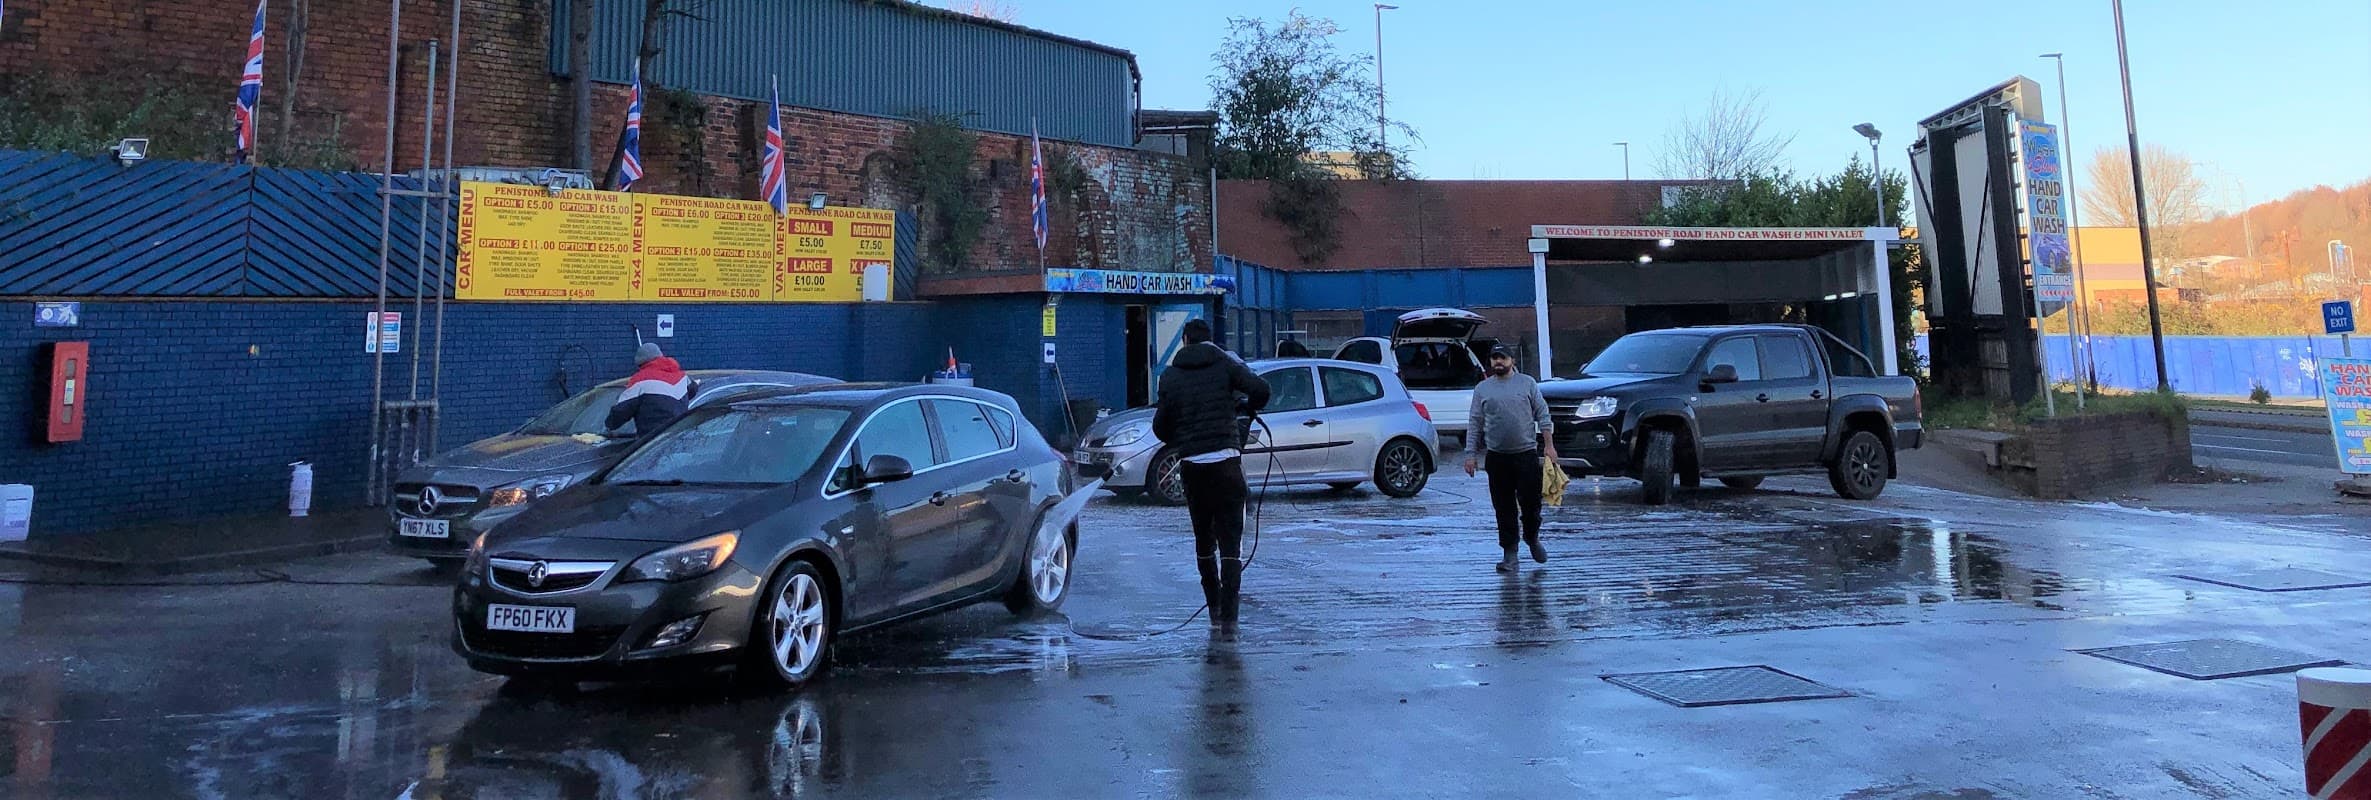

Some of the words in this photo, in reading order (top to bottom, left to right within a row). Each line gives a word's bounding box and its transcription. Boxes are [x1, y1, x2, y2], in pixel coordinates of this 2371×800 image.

[494, 186, 546, 197] PENISTONE
[551, 191, 572, 199] OAD
[574, 192, 592, 201] CAR
[595, 193, 618, 203] WASH
[2028, 179, 2061, 197] HAND
[485, 198, 516, 208] OPTION
[527, 200, 554, 210] £5.00
[561, 202, 589, 212] OPTION
[599, 204, 630, 215] £15.00
[660, 198, 703, 208] PENISTONE
[704, 200, 724, 209] ROAD
[726, 202, 741, 210] CAR
[743, 203, 763, 212] WASH
[2036, 199, 2058, 216] CAR
[461, 189, 475, 245] MENU
[652, 207, 678, 216] OPTION
[715, 212, 739, 220] OPTION
[747, 213, 773, 222] £20.00
[789, 207, 832, 217] PENISTONE
[833, 210, 855, 218] ROAD
[856, 211, 872, 220] CAR
[873, 212, 893, 220] WASH
[633, 202, 644, 253] MENU
[794, 221, 828, 234] SMALL
[852, 224, 890, 237] MEDIUM
[2033, 216, 2065, 234] WASH
[1545, 227, 1593, 236] WELCOME
[1597, 228, 1610, 237] TO
[1613, 228, 1671, 238] PENISTONE
[1673, 229, 1701, 238] ROAD
[1705, 230, 1735, 239] HAND
[1738, 230, 1759, 239] CAR
[1762, 230, 1792, 239] WASH
[1794, 230, 1801, 239] &
[1804, 230, 1828, 239] MINI
[1831, 230, 1864, 238] VALET
[480, 239, 512, 249] OPTION
[522, 239, 555, 250] £11.00
[560, 243, 588, 251] OPTION
[598, 243, 629, 253] £25.00
[799, 237, 824, 248] £5.00
[860, 240, 883, 250] £7.50
[648, 247, 675, 255] OPTION
[683, 247, 711, 256] £15.00
[714, 249, 738, 257] OPTION
[746, 249, 772, 259] £35.00
[459, 250, 472, 290] CAR
[793, 260, 828, 272] LARGE
[632, 258, 642, 290] 4x4
[776, 261, 784, 293] VAN
[795, 276, 825, 286] £10.00
[1106, 274, 1138, 290] HAND
[1140, 275, 1161, 290] CAR
[1164, 275, 1192, 291] WASH
[506, 289, 521, 297] FULL
[523, 289, 544, 297] VALET
[569, 289, 595, 297] £45.00
[660, 289, 679, 297] FULL
[681, 289, 704, 297] VALET
[730, 288, 760, 298] £50.00
[2330, 306, 2344, 316] NO
[2330, 317, 2348, 329] EXIT
[403, 520, 423, 534] YN67
[425, 521, 445, 535] XLS
[493, 607, 531, 627] FP60
[534, 609, 567, 628] FKX
